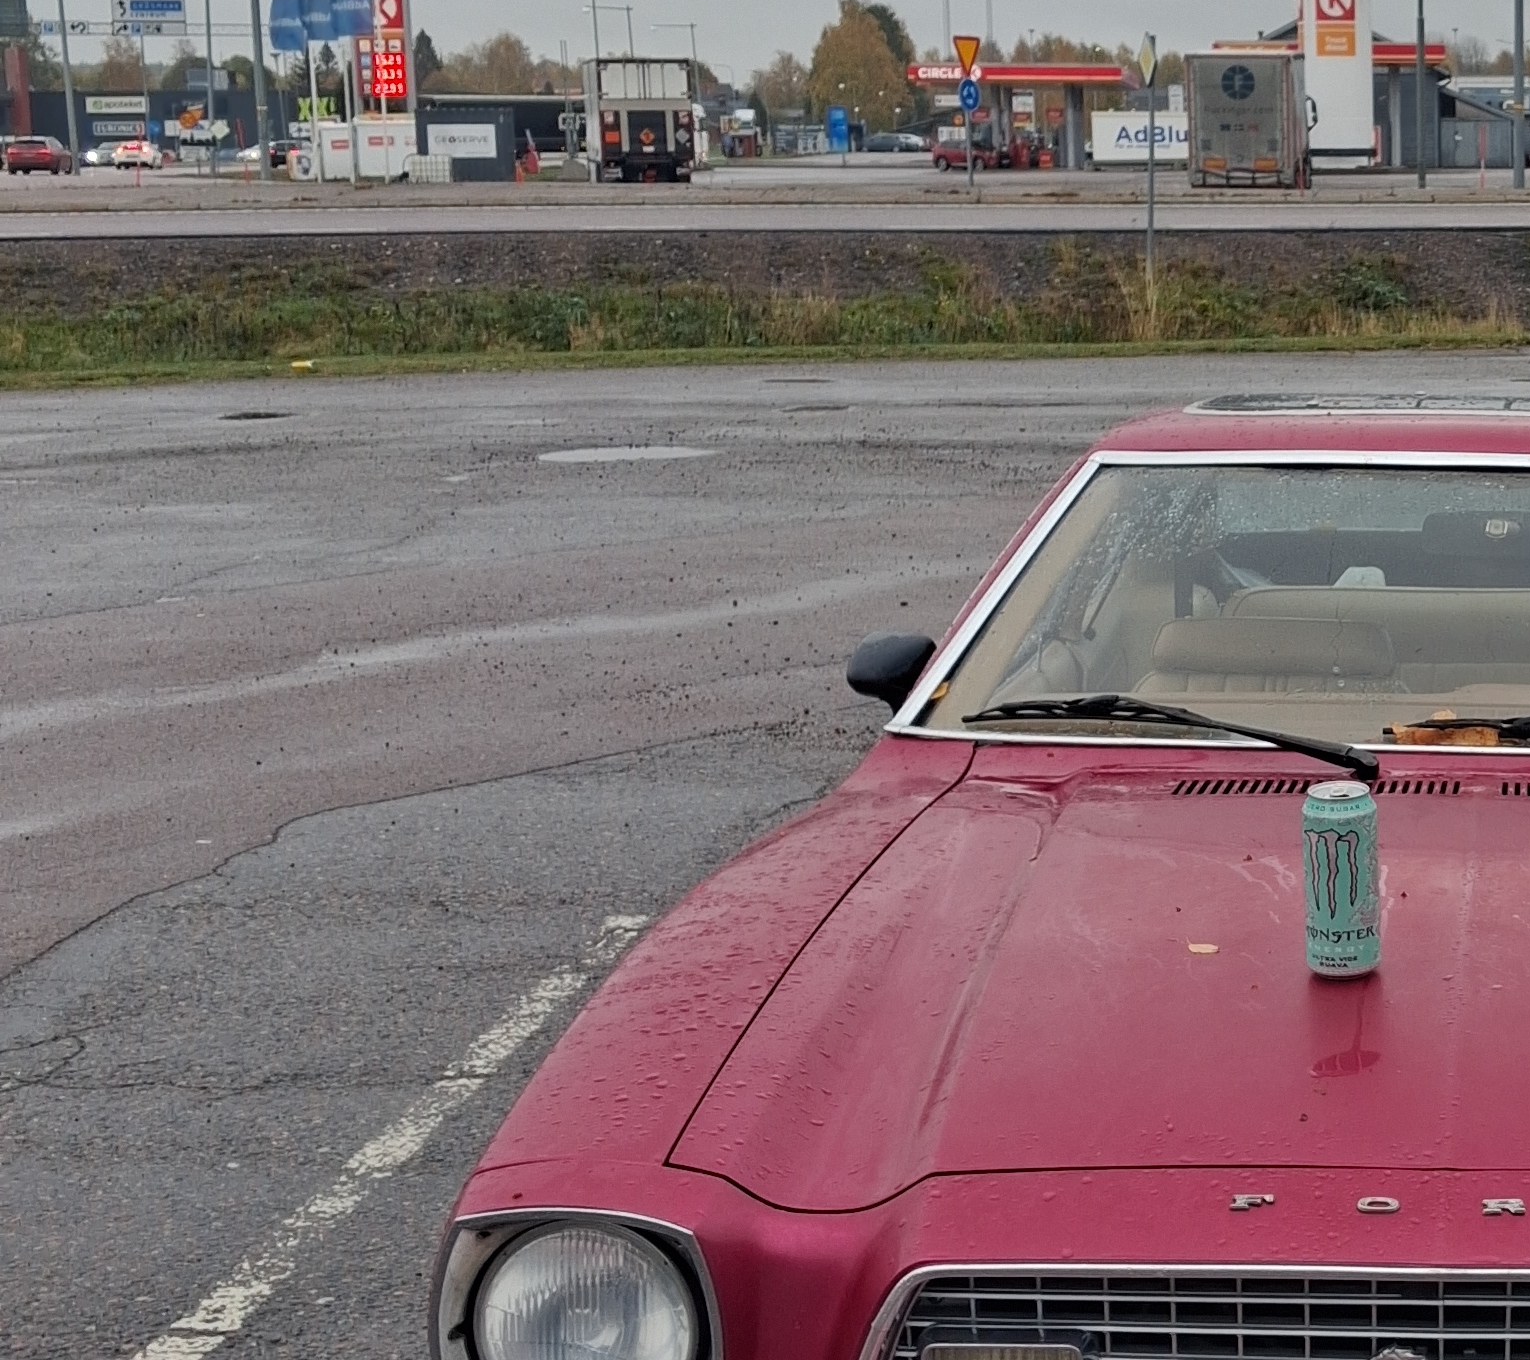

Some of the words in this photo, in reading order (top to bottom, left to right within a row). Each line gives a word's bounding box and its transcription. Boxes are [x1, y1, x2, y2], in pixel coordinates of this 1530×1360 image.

[918, 67, 962, 79] CIRCLE
[1115, 126, 1189, 143] AdBlu
[1330, 804, 1360, 812] SUGAR
[1306, 925, 1375, 943] MONSTER
[1308, 942, 1364, 953] ENERGY
